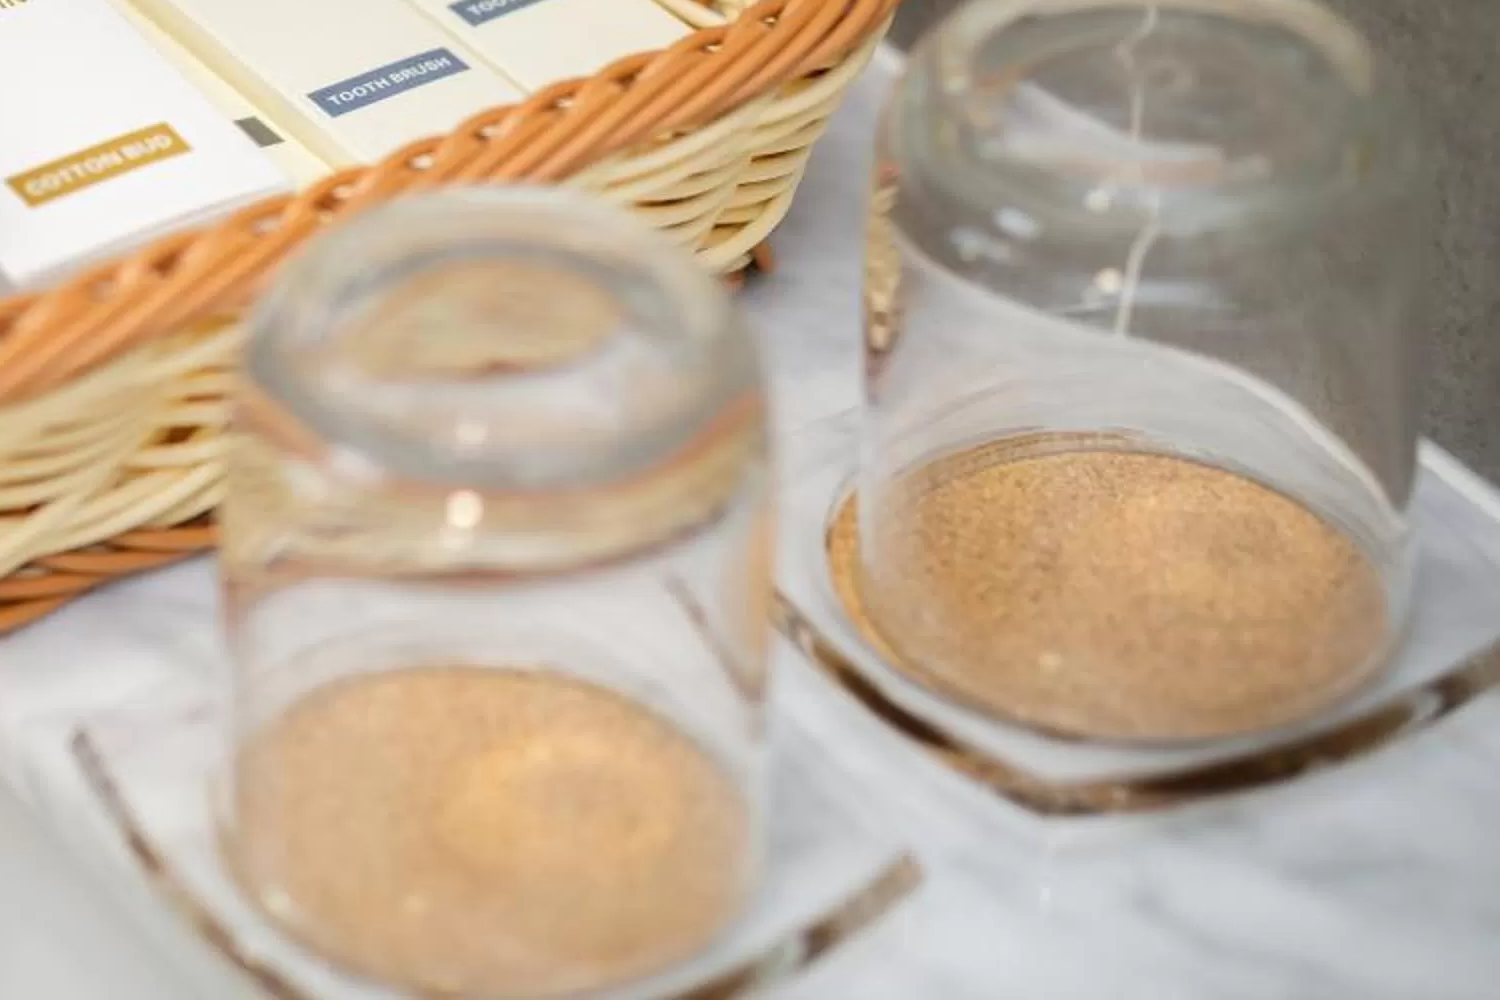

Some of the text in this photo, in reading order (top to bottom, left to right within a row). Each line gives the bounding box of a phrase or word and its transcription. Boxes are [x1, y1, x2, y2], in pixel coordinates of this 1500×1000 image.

[328, 56, 451, 106] TOOTH BRUSH
[24, 134, 173, 196] COTTON BUD
